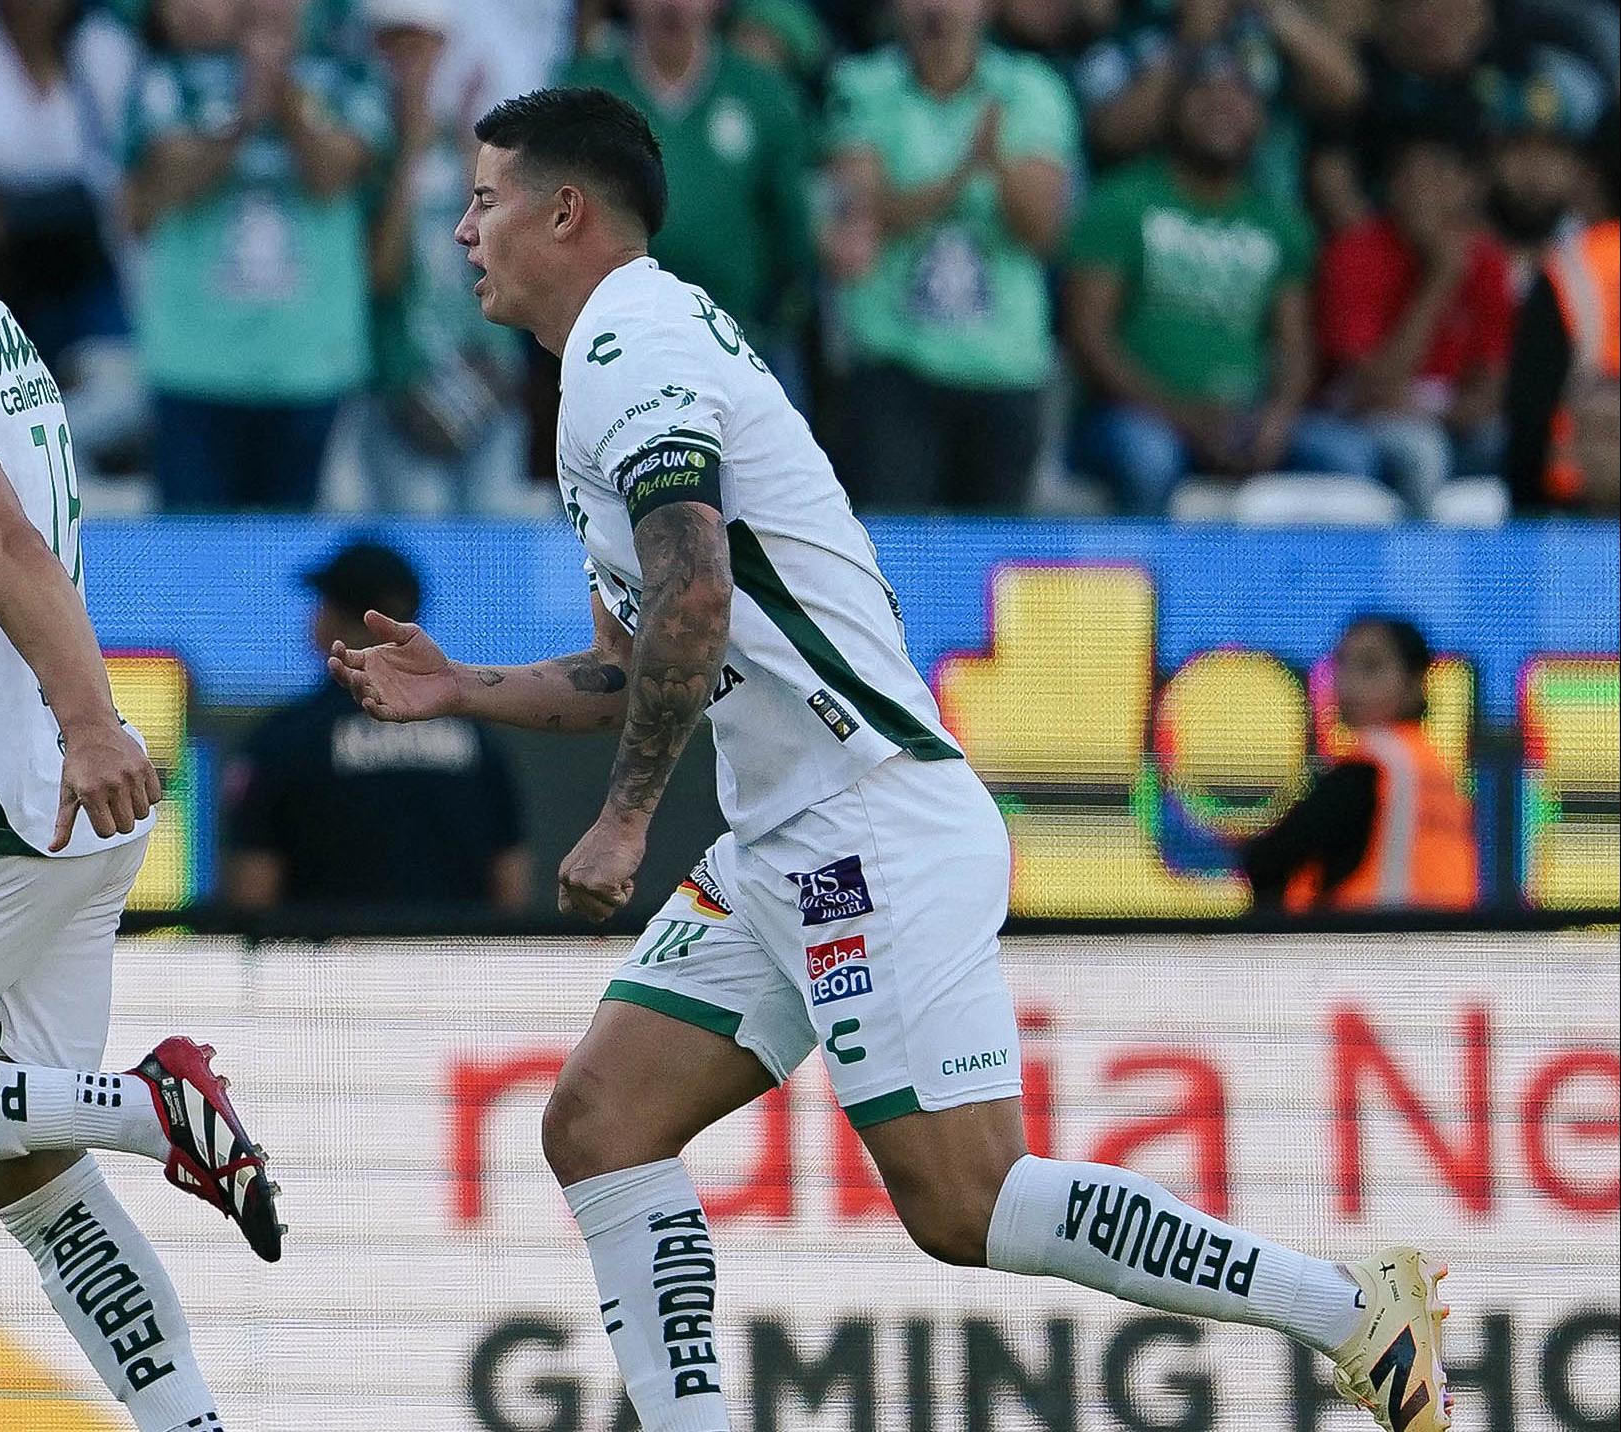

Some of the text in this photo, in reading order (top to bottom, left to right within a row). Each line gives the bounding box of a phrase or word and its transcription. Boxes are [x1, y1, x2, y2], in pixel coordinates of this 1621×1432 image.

[625, 398, 661, 420] Plus
[942, 1048, 1009, 1076] CHARLY
[42, 1200, 177, 1393] PERDURA
[1064, 1179, 1261, 1298] PERDURA
[648, 1208, 722, 1399] PERDURA
[471, 1314, 1214, 1432] GMING
